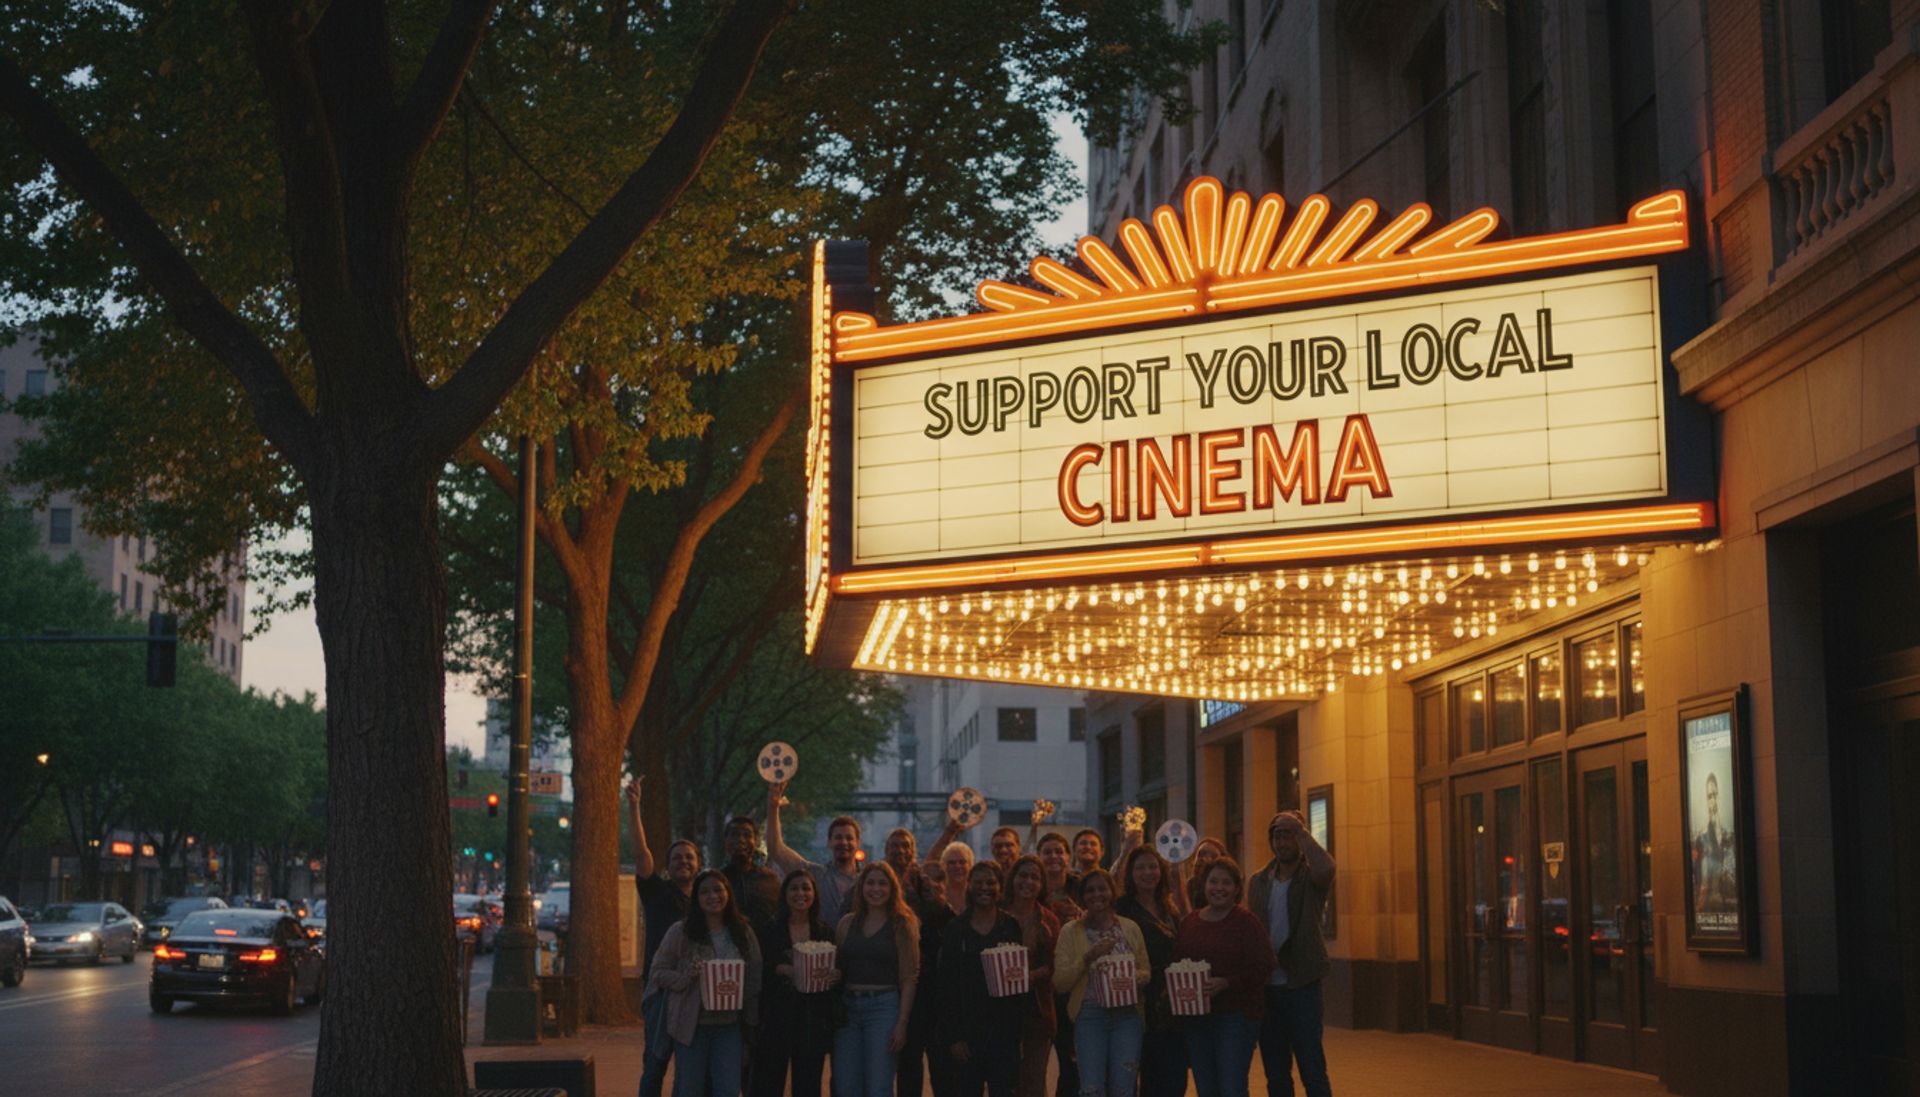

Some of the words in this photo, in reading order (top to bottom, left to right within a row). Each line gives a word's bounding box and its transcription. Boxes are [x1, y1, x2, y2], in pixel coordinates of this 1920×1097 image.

[924, 356, 1170, 440] SUPPORT
[1185, 335, 1349, 409] YOUR
[1366, 308, 1573, 390] LOCAL
[1058, 413, 1393, 527] CINEMA
